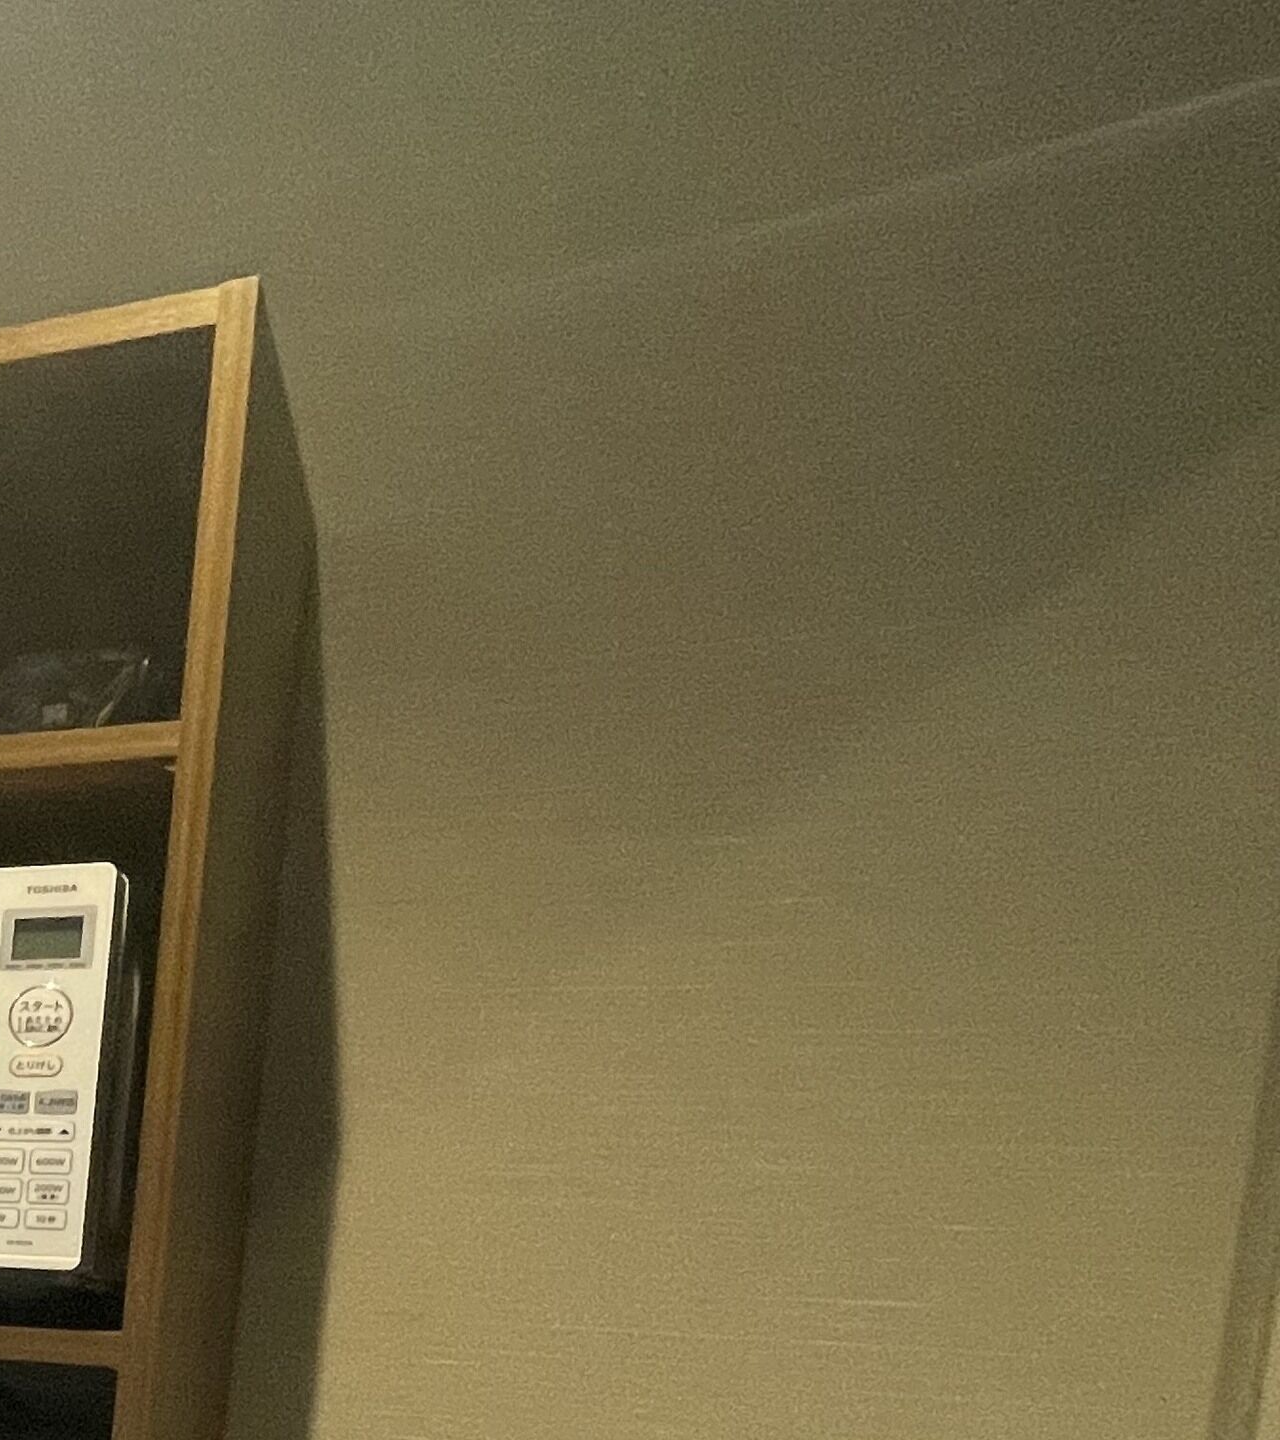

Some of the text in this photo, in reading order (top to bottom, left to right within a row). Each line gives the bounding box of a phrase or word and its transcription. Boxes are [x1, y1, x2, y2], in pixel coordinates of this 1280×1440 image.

[27, 884, 78, 895] TOSHIBA
[19, 1001, 64, 1013] スタート
[15, 1060, 56, 1073] とりけし
[36, 1157, 66, 1166] 600W
